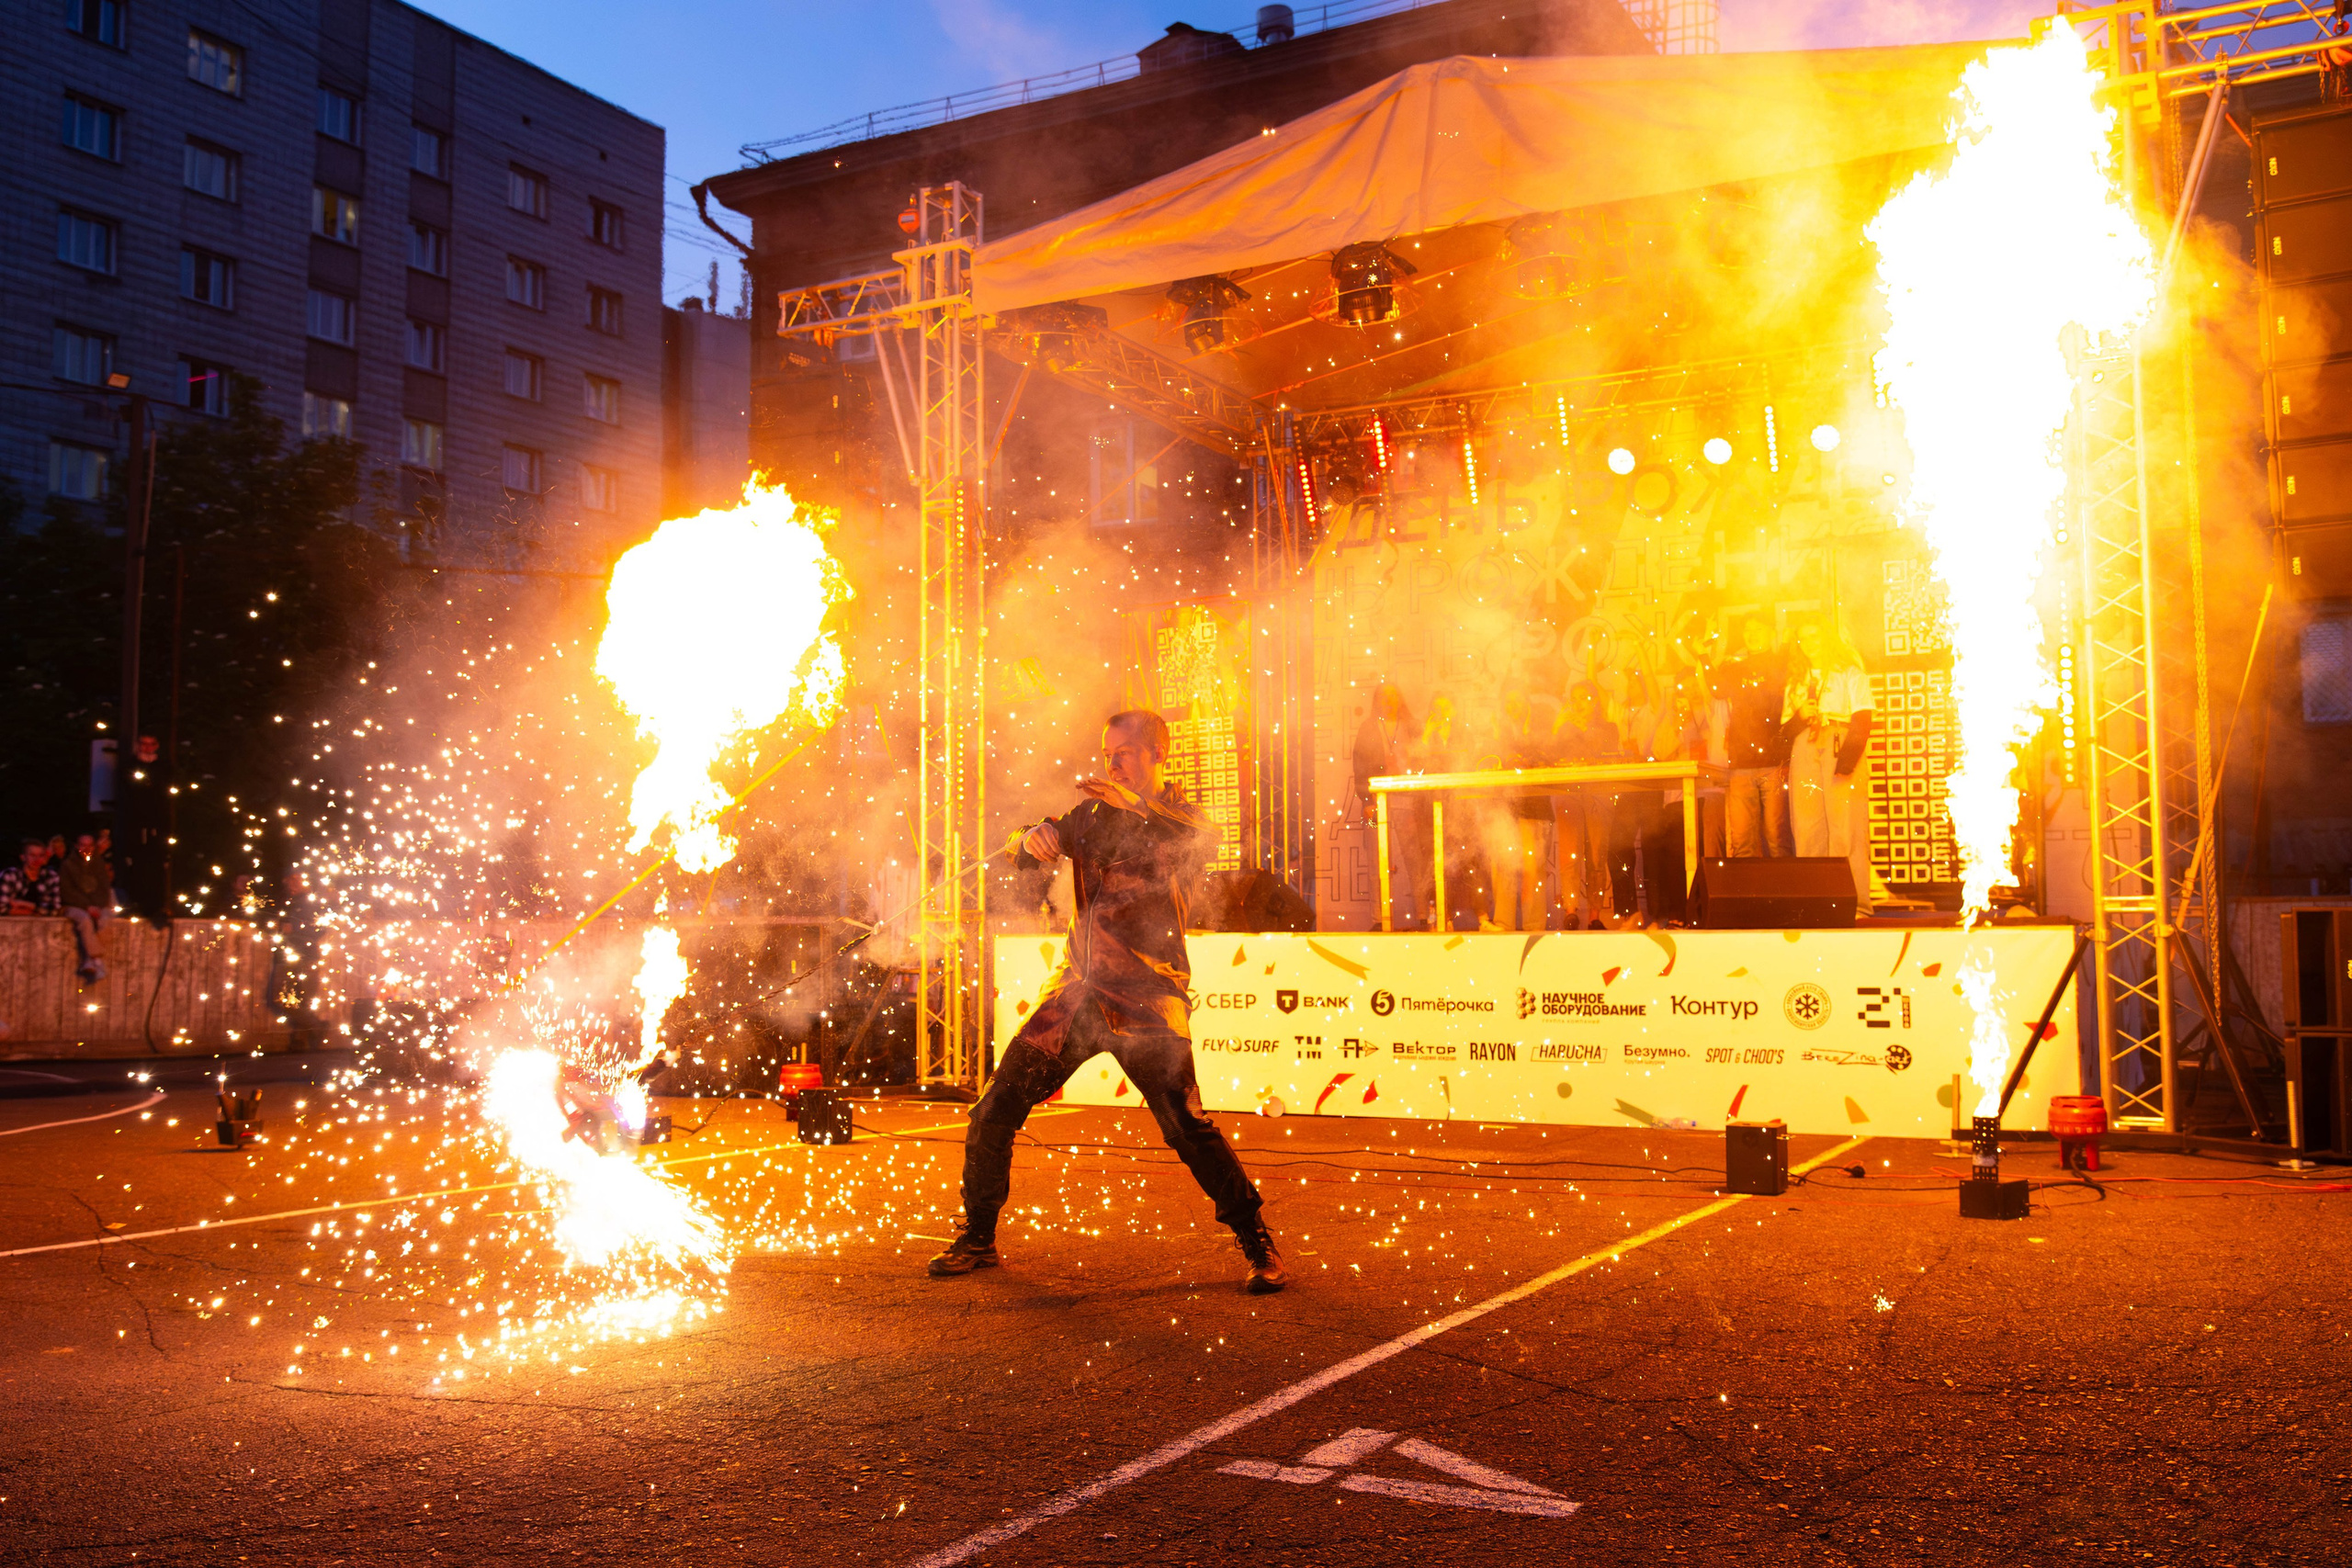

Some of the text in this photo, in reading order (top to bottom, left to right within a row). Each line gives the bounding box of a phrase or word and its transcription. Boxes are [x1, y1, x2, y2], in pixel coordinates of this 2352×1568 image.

[1205, 993, 1257, 1010] СБЕР
[1303, 996, 1350, 1009] BANK
[1401, 997, 1494, 1015] Пятёрочка
[1542, 992, 1605, 1005] НАУЧНОЕ
[1542, 1004, 1646, 1017] ОБОРУДОВАНИЕ
[1670, 995, 1758, 1020] Контур
[1202, 1038, 1280, 1054] FLY SURF
[1469, 1042, 1516, 1062] RAYON
[1539, 1043, 1602, 1060] HARUCHA
[1624, 1044, 1690, 1060] Безумно.
[1705, 1047, 1734, 1064] SPOT
[1743, 1049, 1785, 1065] CHOO'S
